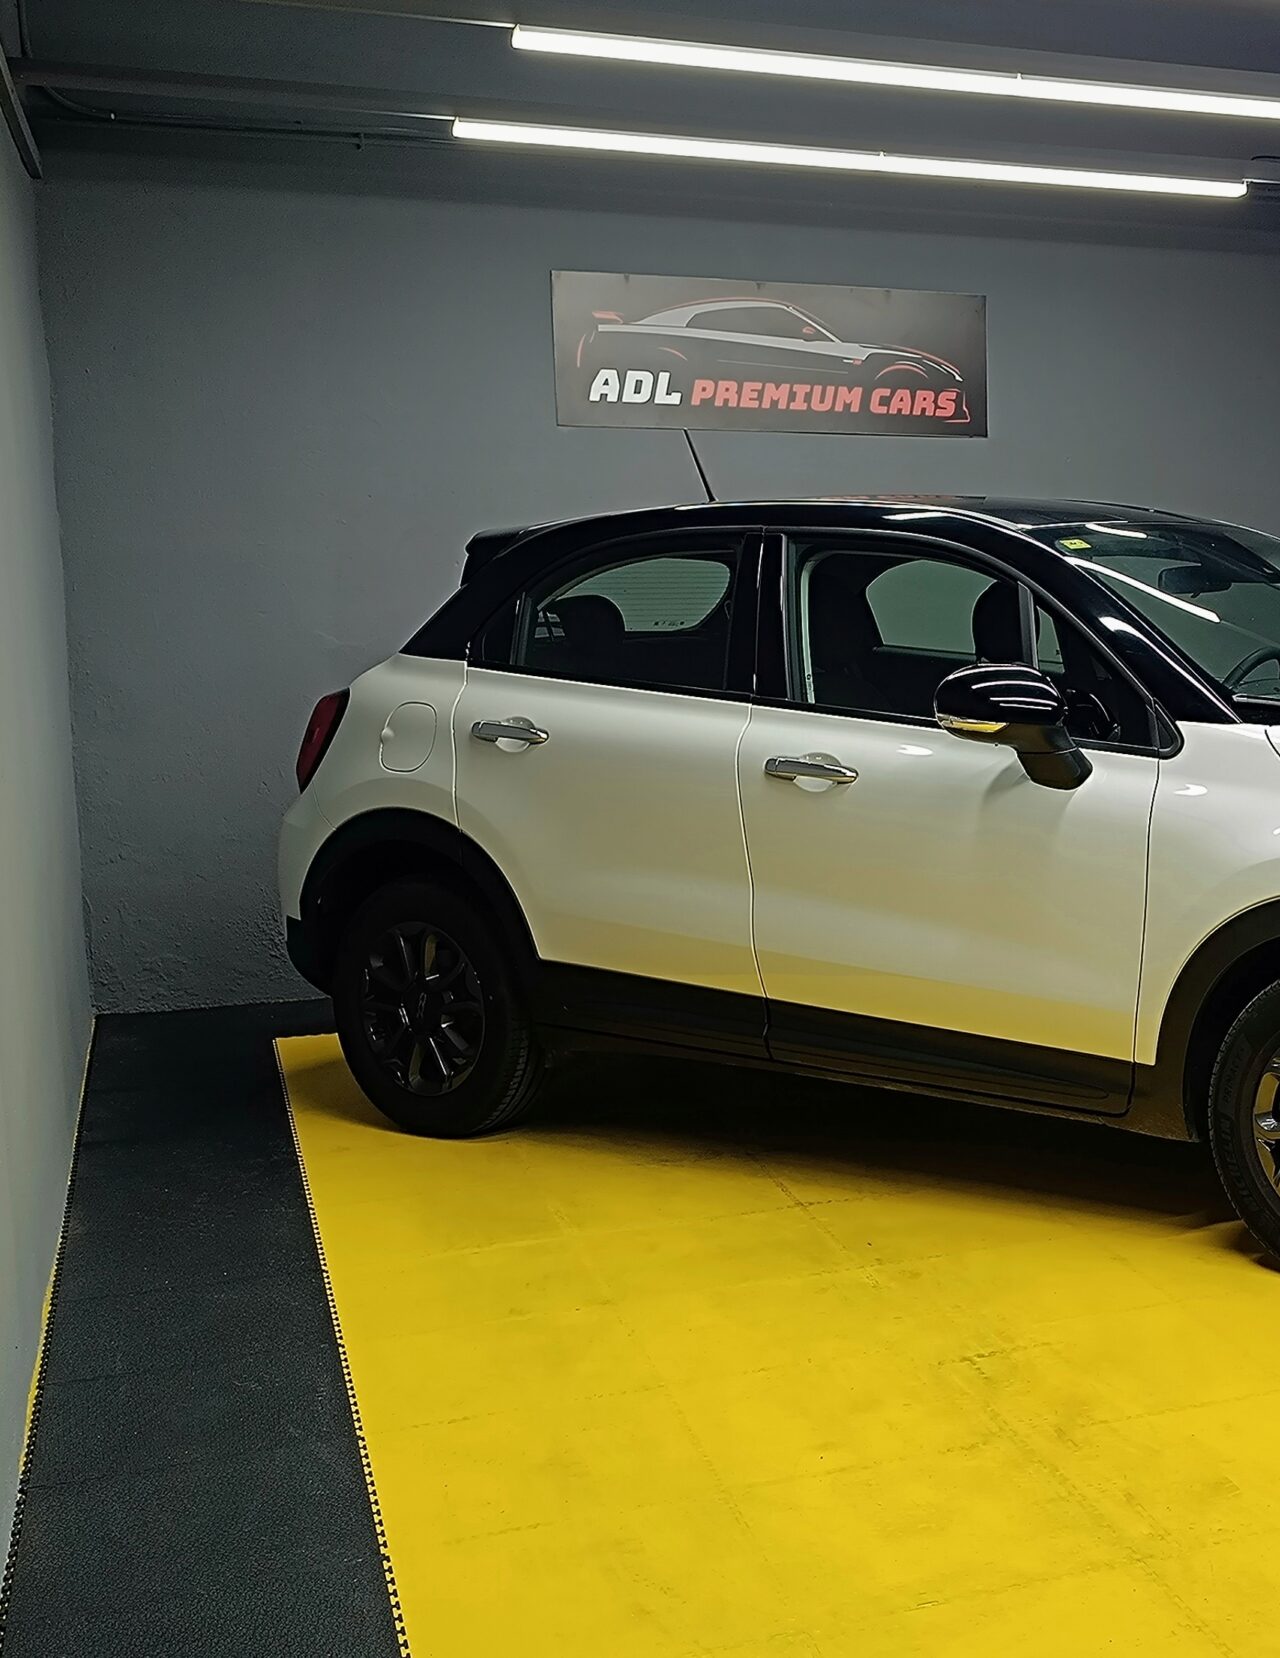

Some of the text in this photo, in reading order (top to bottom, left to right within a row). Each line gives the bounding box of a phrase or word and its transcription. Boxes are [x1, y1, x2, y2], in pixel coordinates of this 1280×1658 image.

[588, 368, 957, 418] ADL PREMIUM CARS
